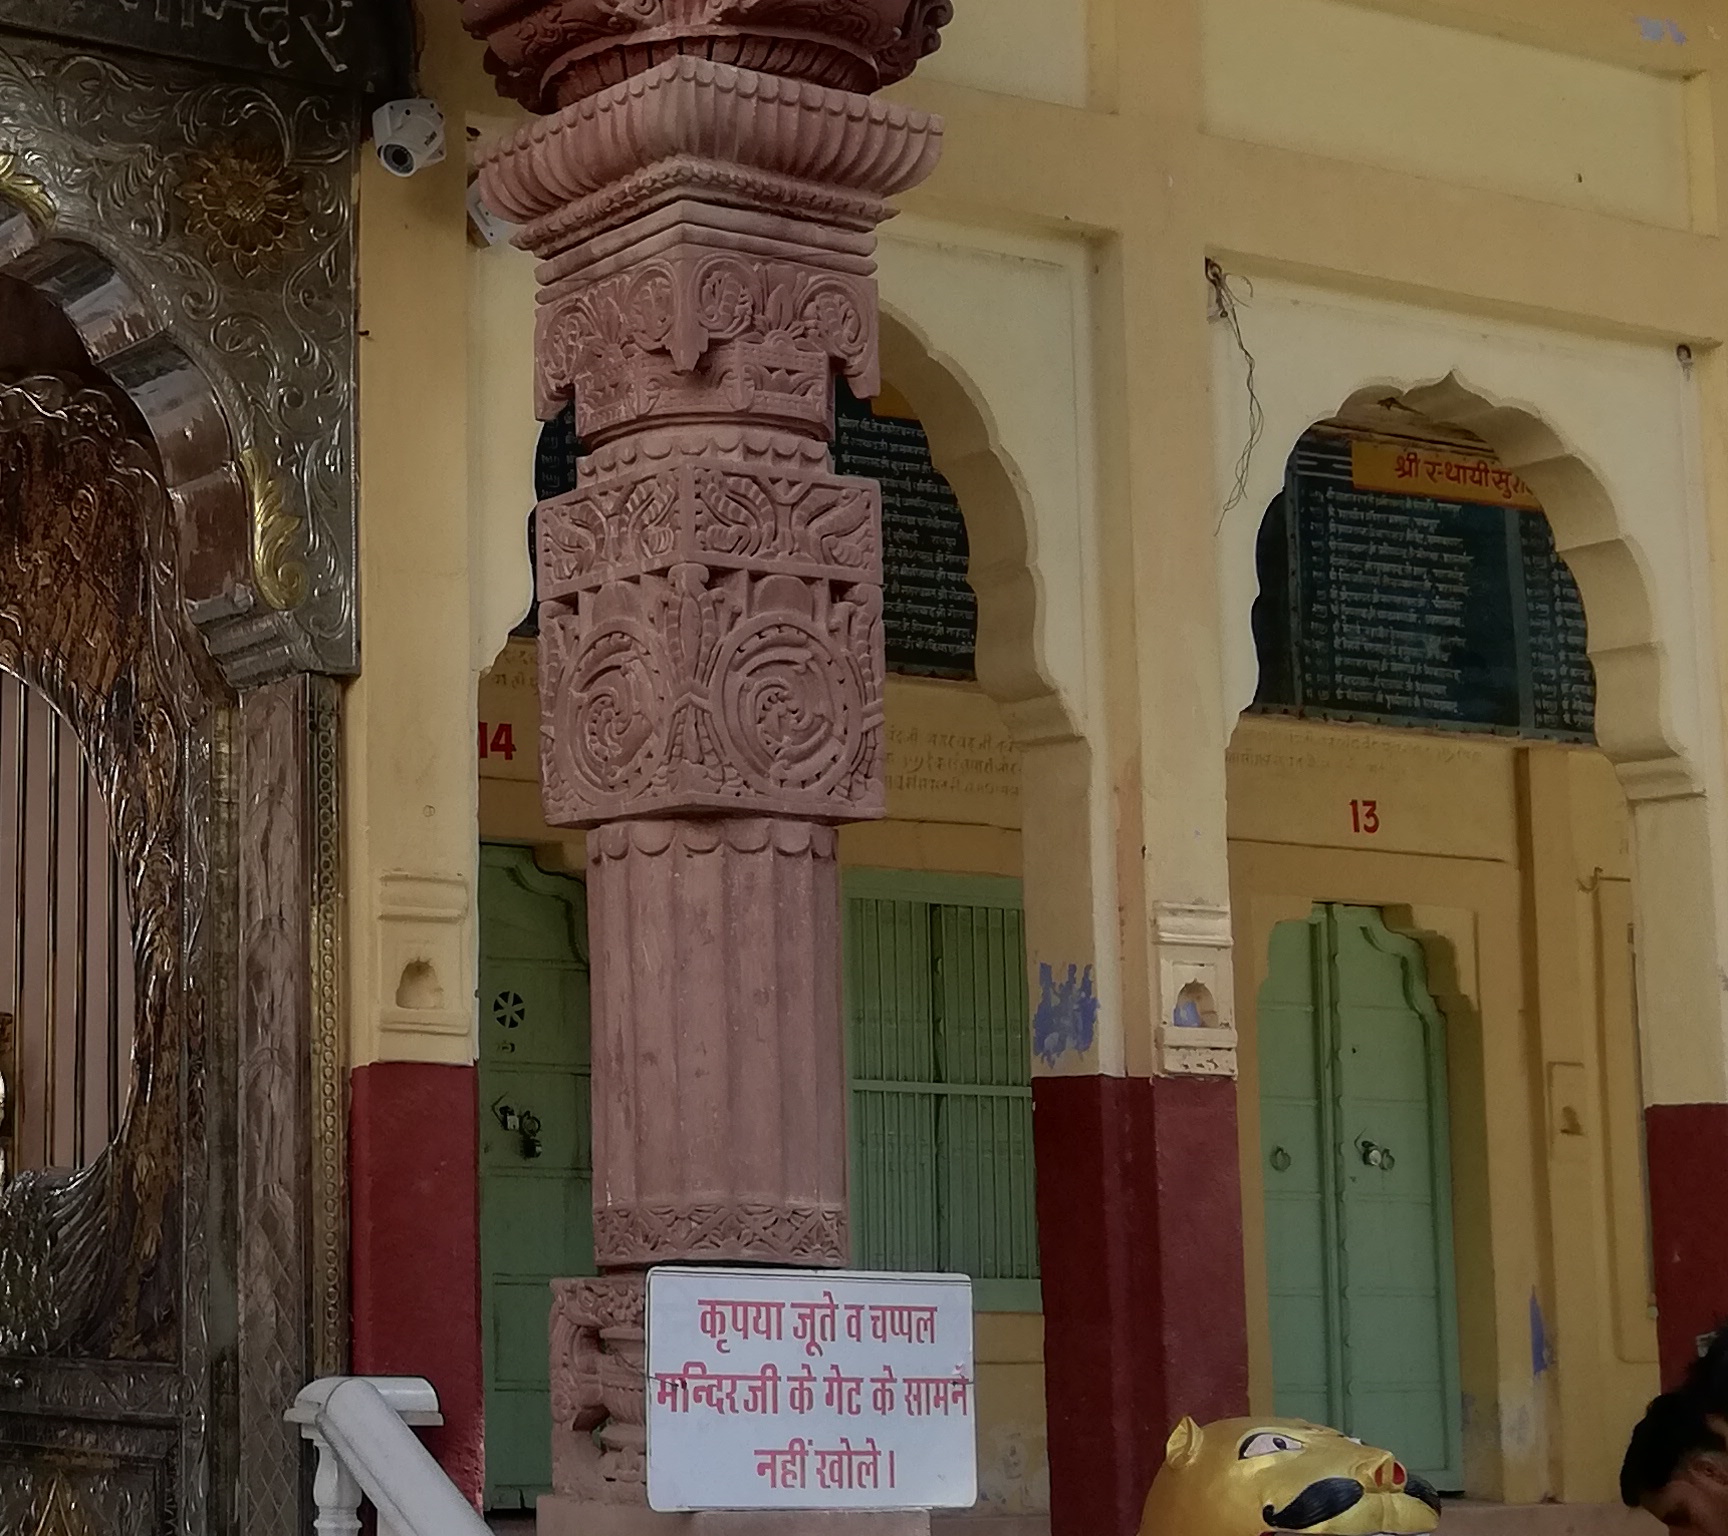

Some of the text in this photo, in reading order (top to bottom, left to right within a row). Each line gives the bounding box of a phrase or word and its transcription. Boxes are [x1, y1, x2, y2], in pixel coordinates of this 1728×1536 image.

[1394, 451, 1421, 478] श्री
[478, 721, 517, 761] 14
[1349, 799, 1380, 833] 13
[697, 1290, 938, 1357] कृपया जूते व चप्पल
[786, 1363, 817, 1415] के
[823, 1364, 864, 1416] गेट
[869, 1365, 898, 1416] के
[754, 1438, 813, 1490] नहीं
